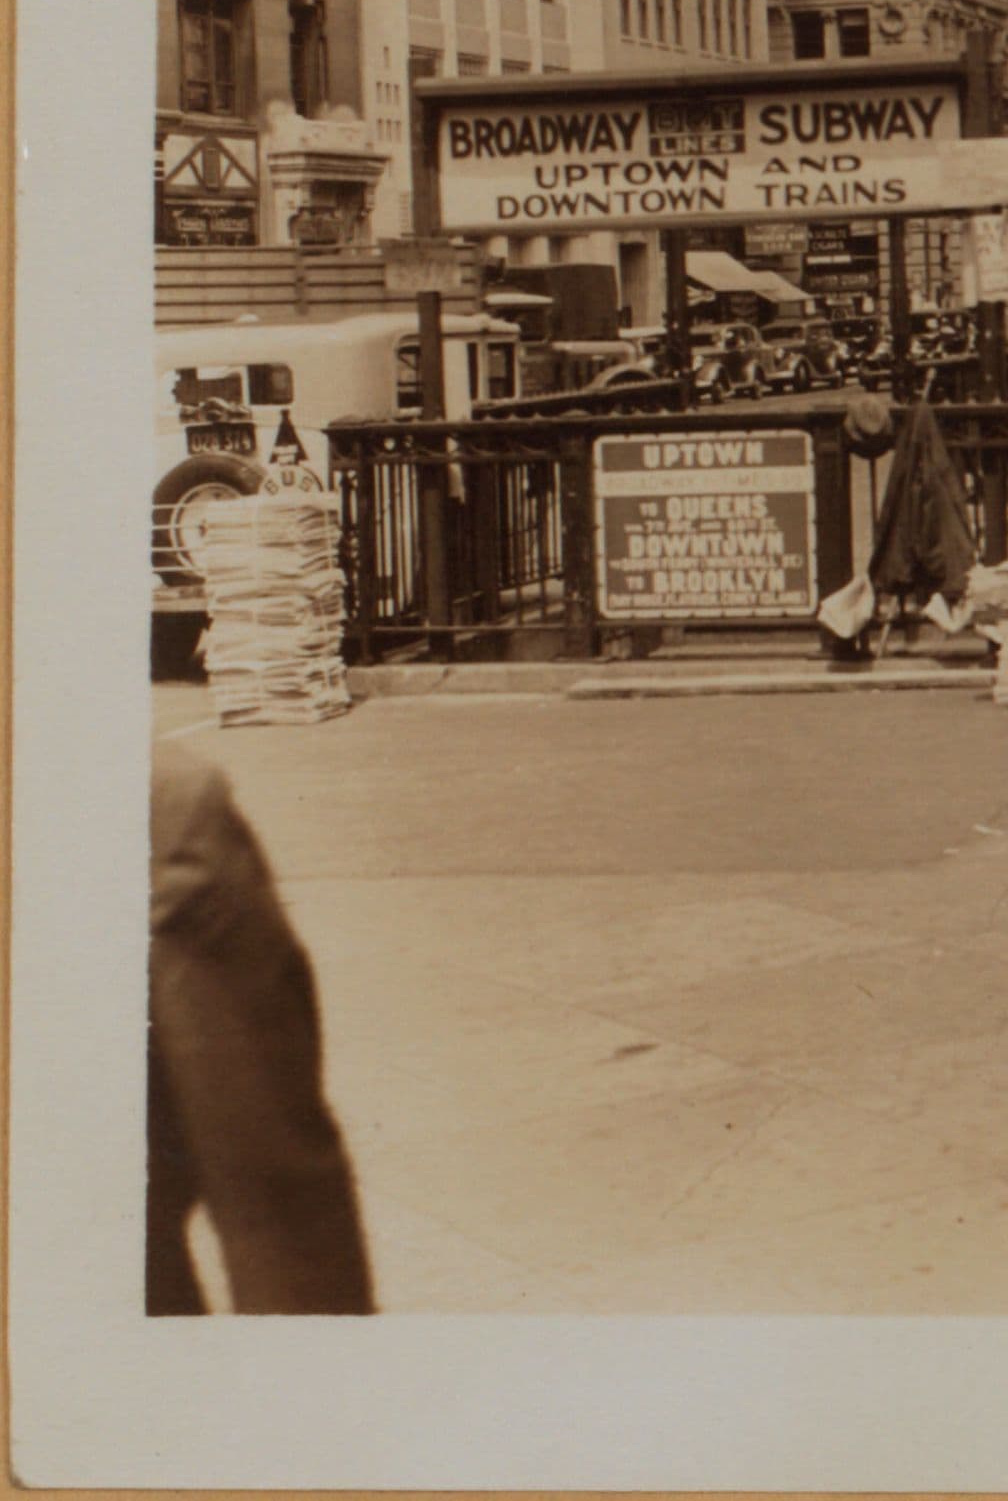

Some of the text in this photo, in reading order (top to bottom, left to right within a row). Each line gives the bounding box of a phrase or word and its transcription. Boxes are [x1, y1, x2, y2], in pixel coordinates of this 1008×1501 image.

[449, 98, 944, 159] BROADWAY SUBWAY
[659, 134, 736, 154] LINES
[535, 154, 862, 189] UPTOWN AND
[497, 179, 907, 220] DOWNTOWN TRAINS
[643, 441, 764, 468] UPTOWN
[264, 470, 314, 496] BUS
[666, 494, 769, 520] QUEENS
[629, 532, 785, 558] DOWNTOWN
[653, 569, 786, 593] BROOKLYN
